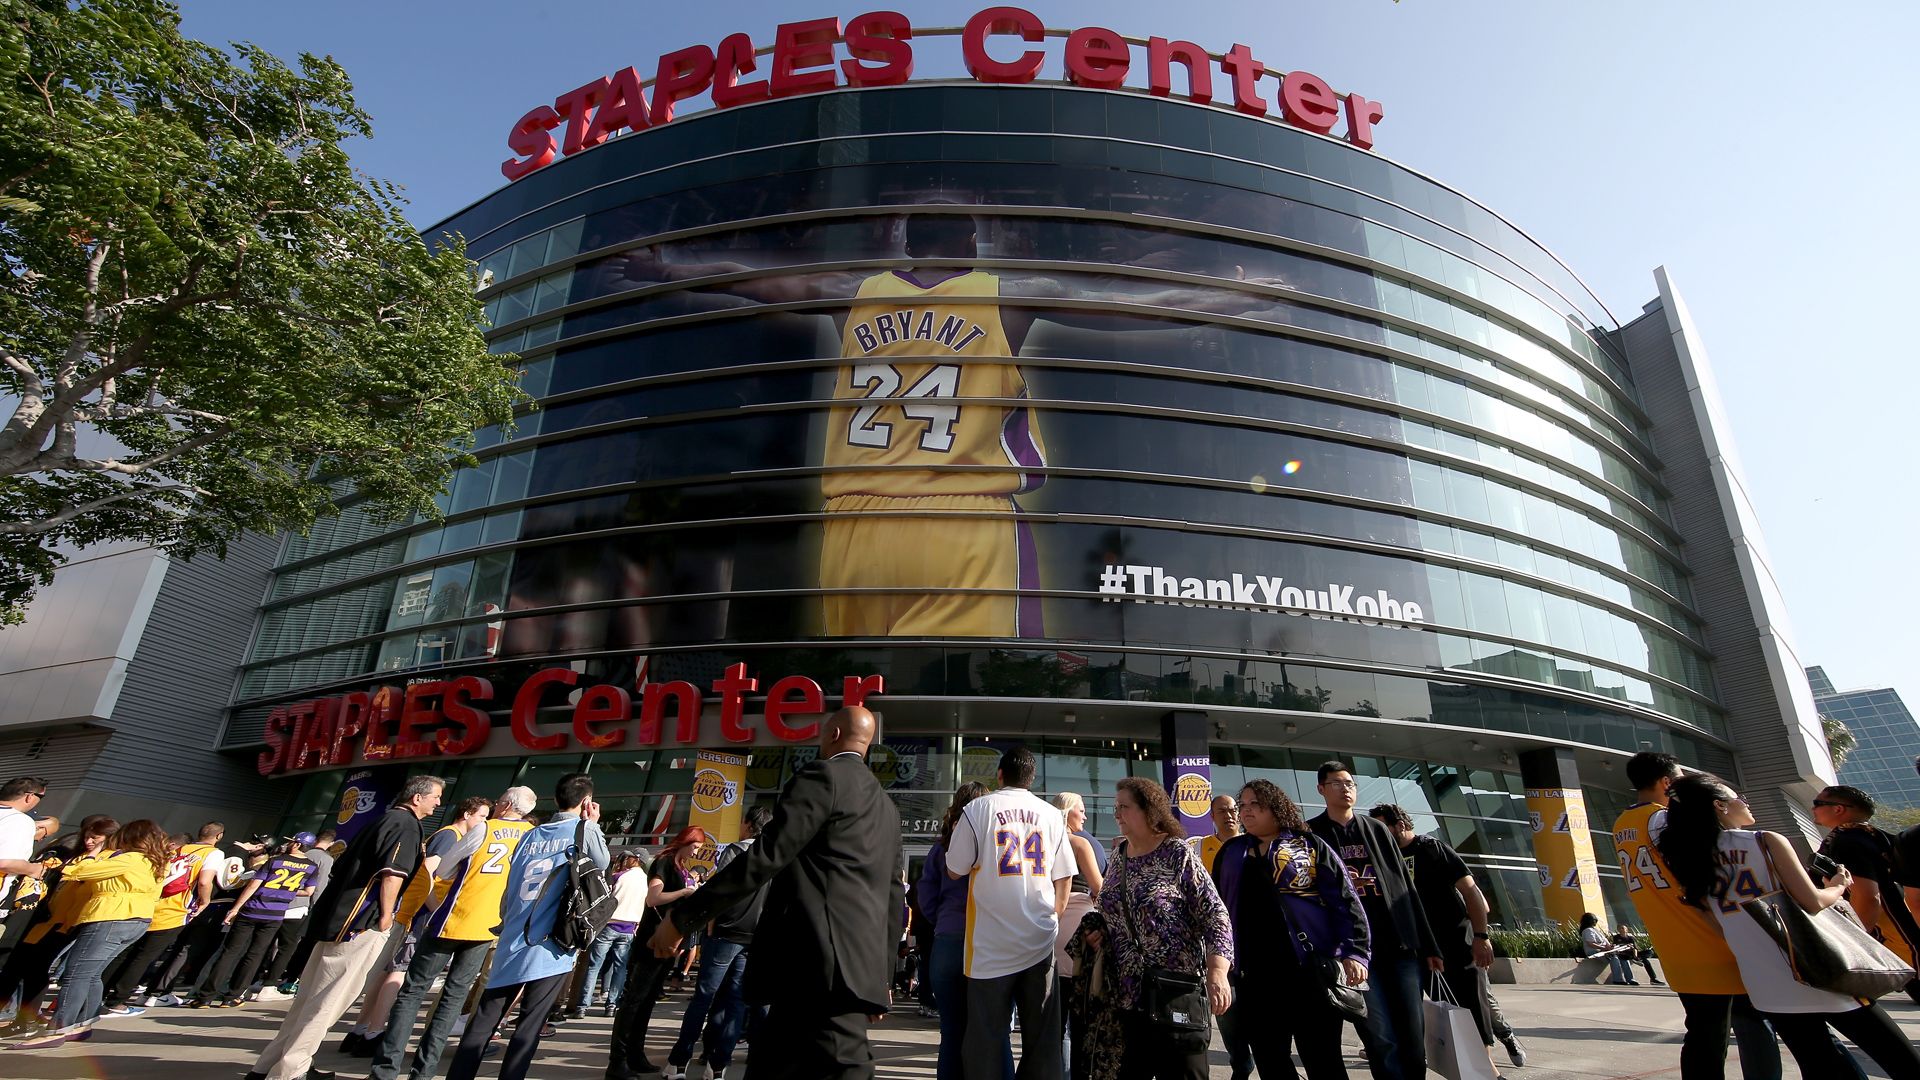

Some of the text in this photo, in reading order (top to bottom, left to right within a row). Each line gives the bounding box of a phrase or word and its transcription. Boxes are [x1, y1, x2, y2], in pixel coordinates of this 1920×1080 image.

[501, 6, 1384, 182] STAPLES Center
[853, 310, 986, 353] BRYANT
[847, 363, 962, 453] 24
[1099, 565, 1424, 632] #ThankYouKobe
[258, 675, 494, 776] STAPLES
[493, 828, 527, 841] BRYA
[913, 819, 944, 832] STR
[996, 808, 1040, 826] BRYANT
[282, 860, 310, 871] BRYANT
[478, 843, 513, 874] 2
[522, 838, 569, 857] BRYANT
[994, 828, 1045, 877] 24
[230, 863, 239, 874] 8
[264, 868, 306, 892] 24
[519, 857, 554, 901] 8
[1616, 845, 1671, 893] 24
